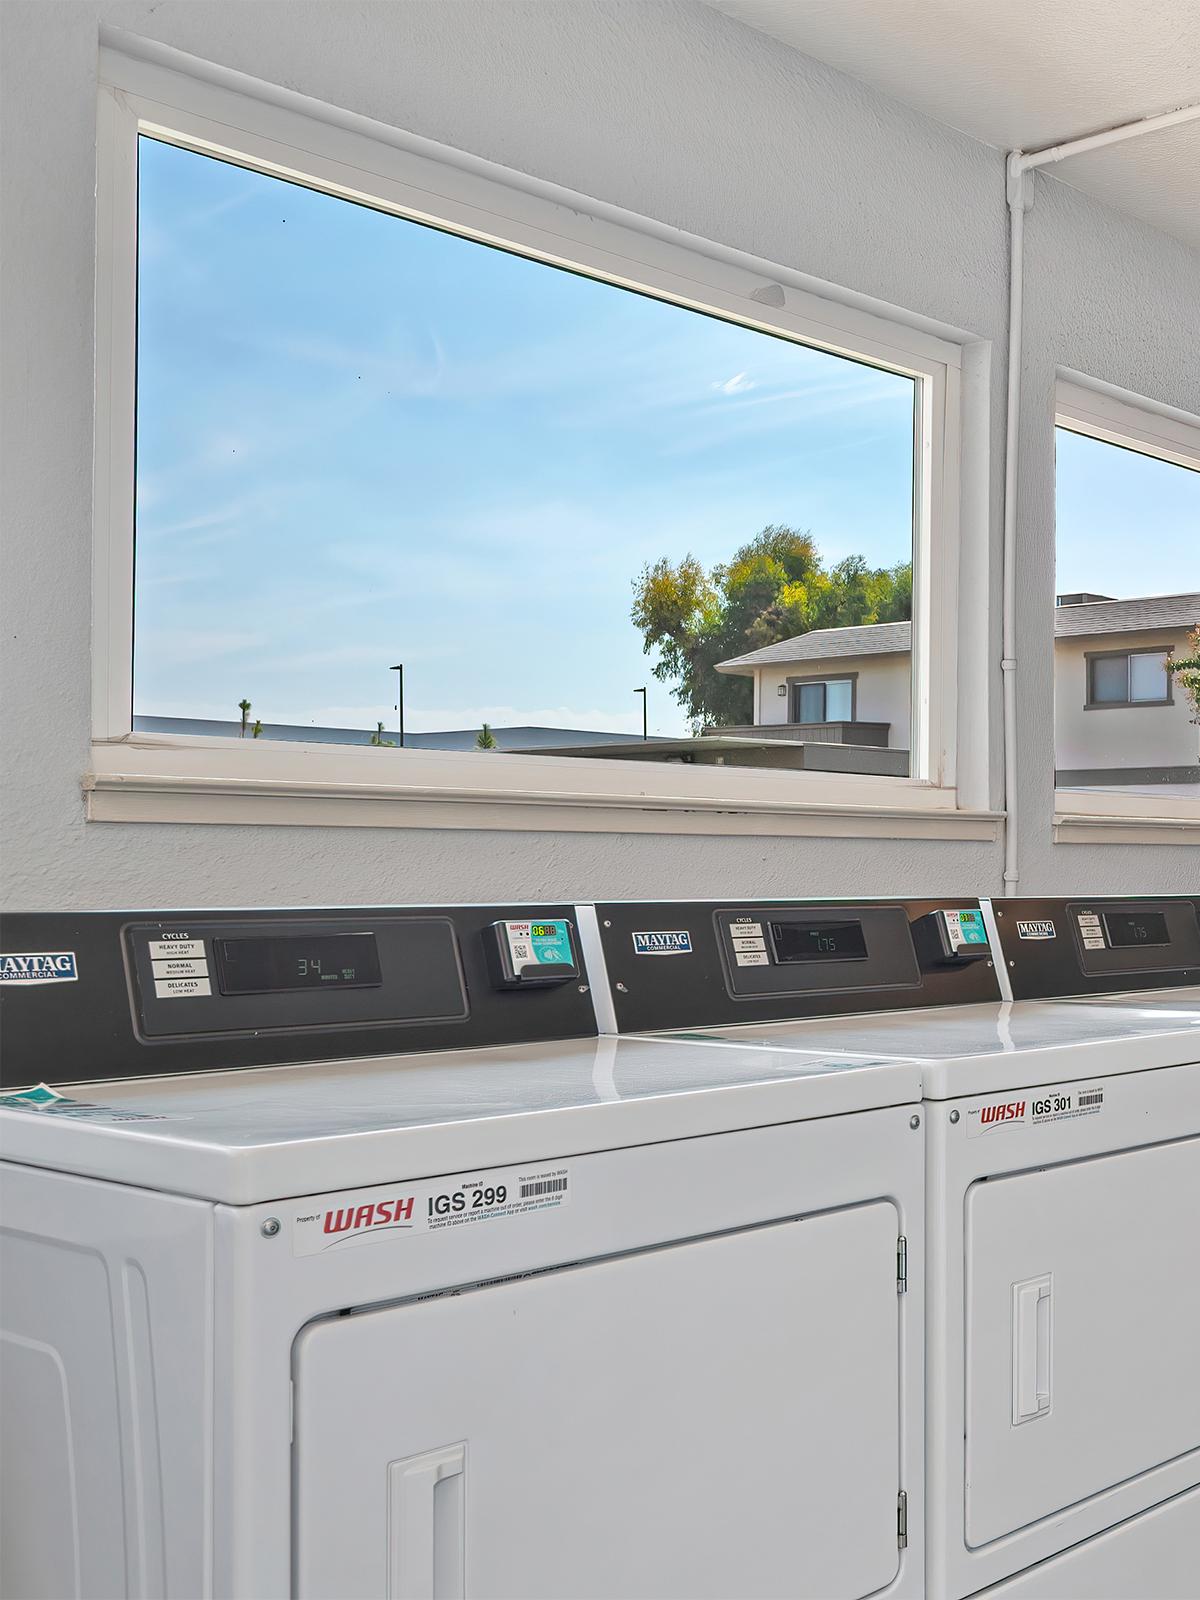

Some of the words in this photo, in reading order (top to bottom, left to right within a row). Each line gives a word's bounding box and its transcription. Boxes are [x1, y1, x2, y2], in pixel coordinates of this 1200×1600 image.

[1020, 922, 1052, 932] MAYTAG
[162, 932, 189, 940] CYCLES
[637, 933, 688, 946] MAYTAG
[298, 959, 321, 976] 34
[981, 1101, 1025, 1124] WASH
[1032, 1099, 1052, 1116] IGS
[1054, 1096, 1071, 1112] 301
[461, 1181, 478, 1190] Machine
[428, 1192, 465, 1216] IGS
[472, 1185, 507, 1208] 299
[297, 1215, 315, 1223] Property
[323, 1197, 414, 1234] WASH
